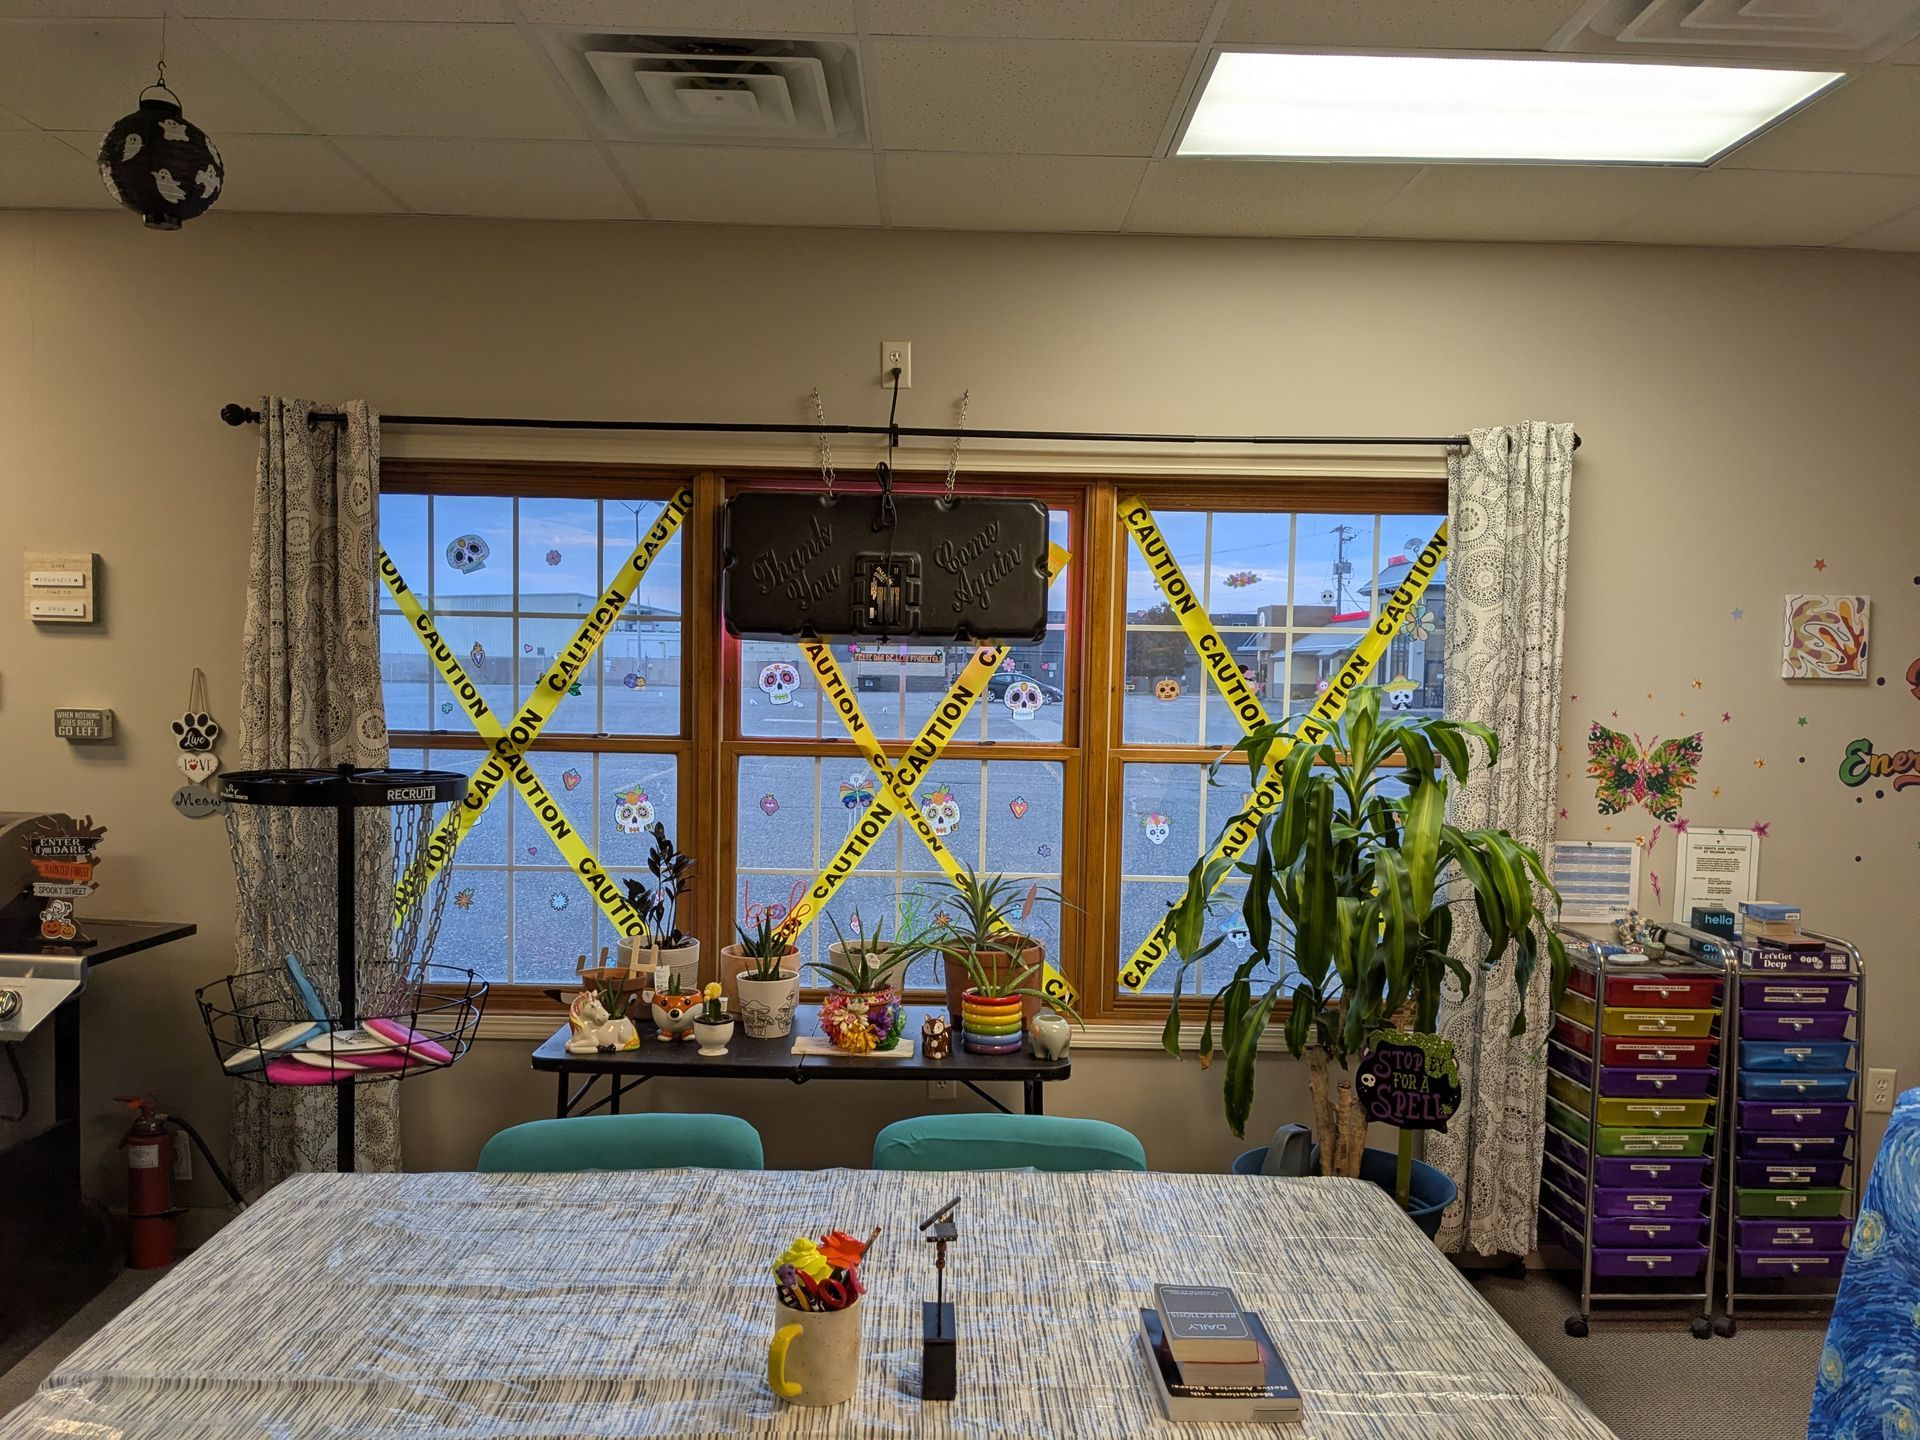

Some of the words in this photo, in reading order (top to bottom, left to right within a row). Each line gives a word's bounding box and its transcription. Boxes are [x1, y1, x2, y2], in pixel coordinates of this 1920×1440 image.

[633, 490, 694, 572] CAUTIO
[933, 519, 1000, 575] Come
[952, 543, 1022, 613] Again
[1127, 507, 1197, 615] CAUTION
[1375, 532, 1448, 636] CAUTION
[415, 613, 489, 719] CAUTION
[548, 589, 626, 692] CAUTION
[56, 711, 74, 719] WHEN
[806, 645, 864, 732] AUTION
[1304, 653, 1370, 744] AUTION
[58, 726, 73, 736] GO
[76, 726, 100, 737] LEFT
[184, 731, 205, 747] Live
[897, 684, 975, 786] CAUTION
[175, 792, 222, 807] Meow
[387, 787, 434, 801] RECRUIT
[495, 736, 569, 840] CAUTION
[873, 753, 943, 853] CAUTION
[1222, 775, 1282, 857] AUTION
[40, 838, 81, 846] ENTER
[52, 846, 86, 854] DARE
[812, 802, 893, 899] CAUTION
[38, 886, 63, 895] SPOOKY
[64, 887, 87, 896] STREET
[579, 857, 645, 937] CAUTIO
[1704, 914, 1733, 926] hella
[1764, 959, 1787, 970] Deep
[1373, 1049, 1424, 1078] STOP
[1429, 1056, 1445, 1073] BY
[1392, 1072, 1417, 1090] FOR
[1420, 1076, 1430, 1094] A
[1370, 1084, 1449, 1124] SPELL
[1188, 1322, 1228, 1331] DAILY
